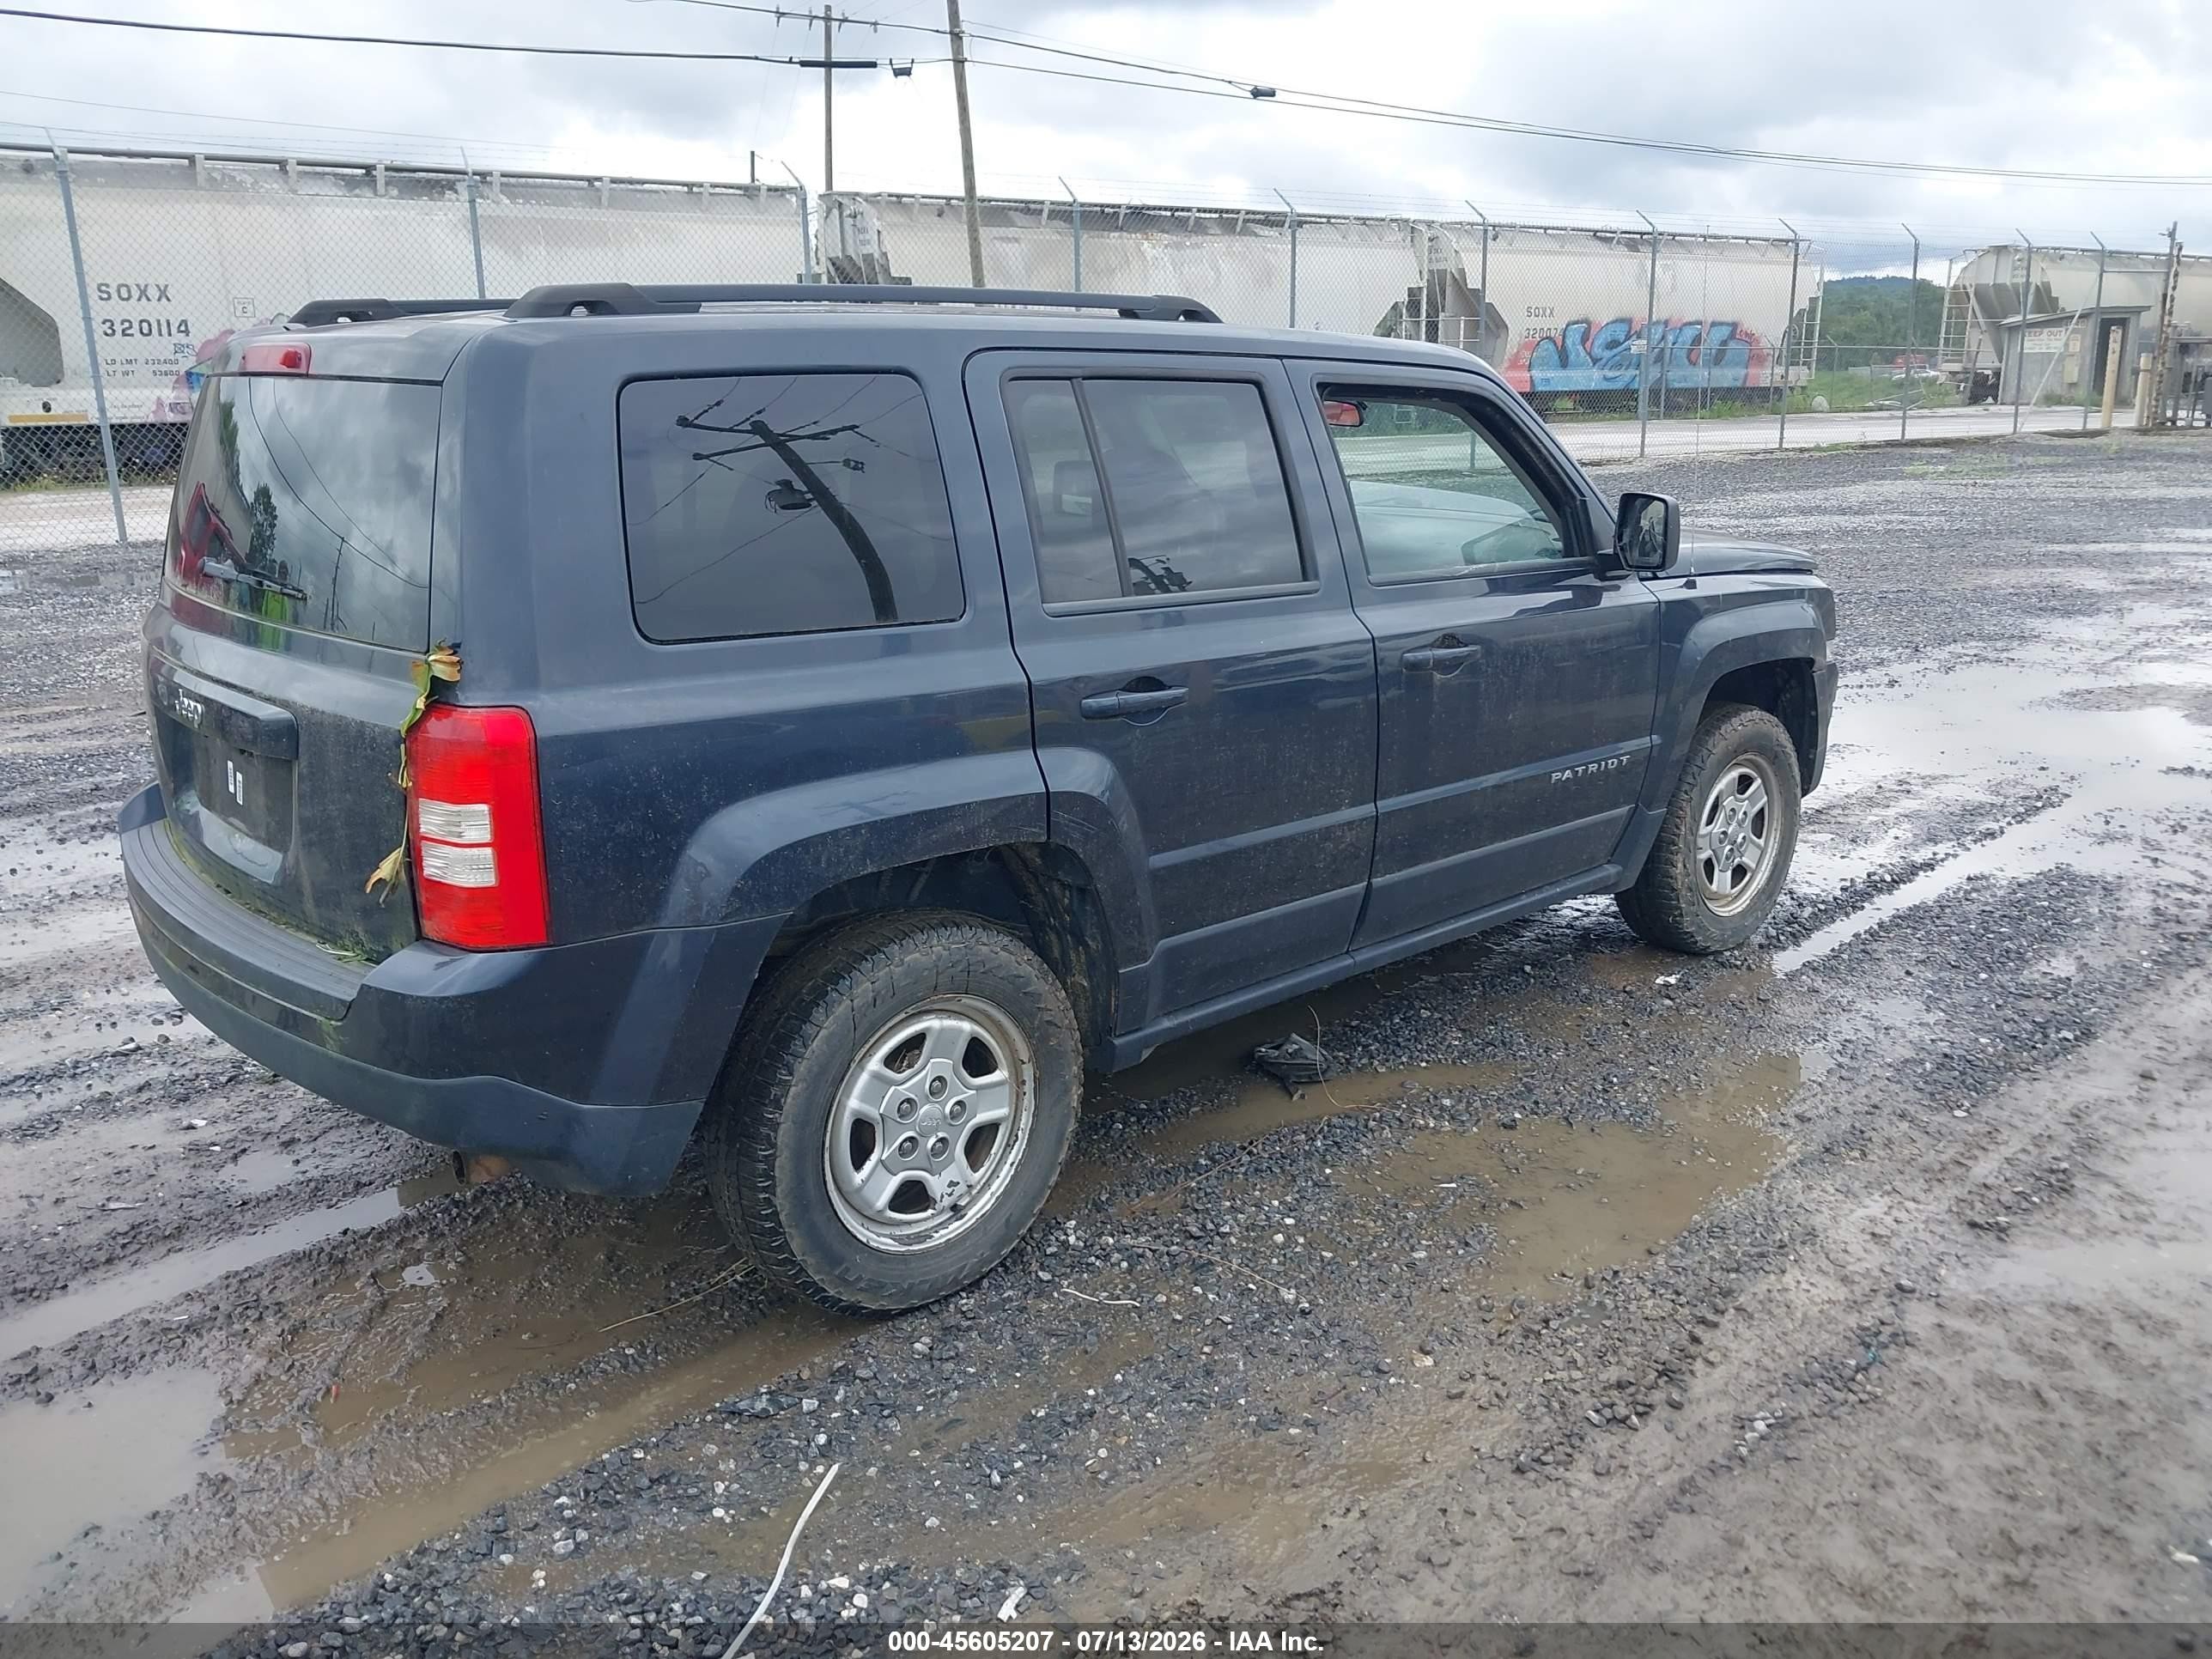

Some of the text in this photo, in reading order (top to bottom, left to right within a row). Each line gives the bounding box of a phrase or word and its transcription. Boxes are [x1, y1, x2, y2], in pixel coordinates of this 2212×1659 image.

[97, 283, 172, 302] SOXX
[1526, 306, 1554, 319] SOXX
[100, 318, 191, 337] 320114
[174, 688, 204, 728] Jeep
[1550, 755, 1631, 783] PATRIOT
